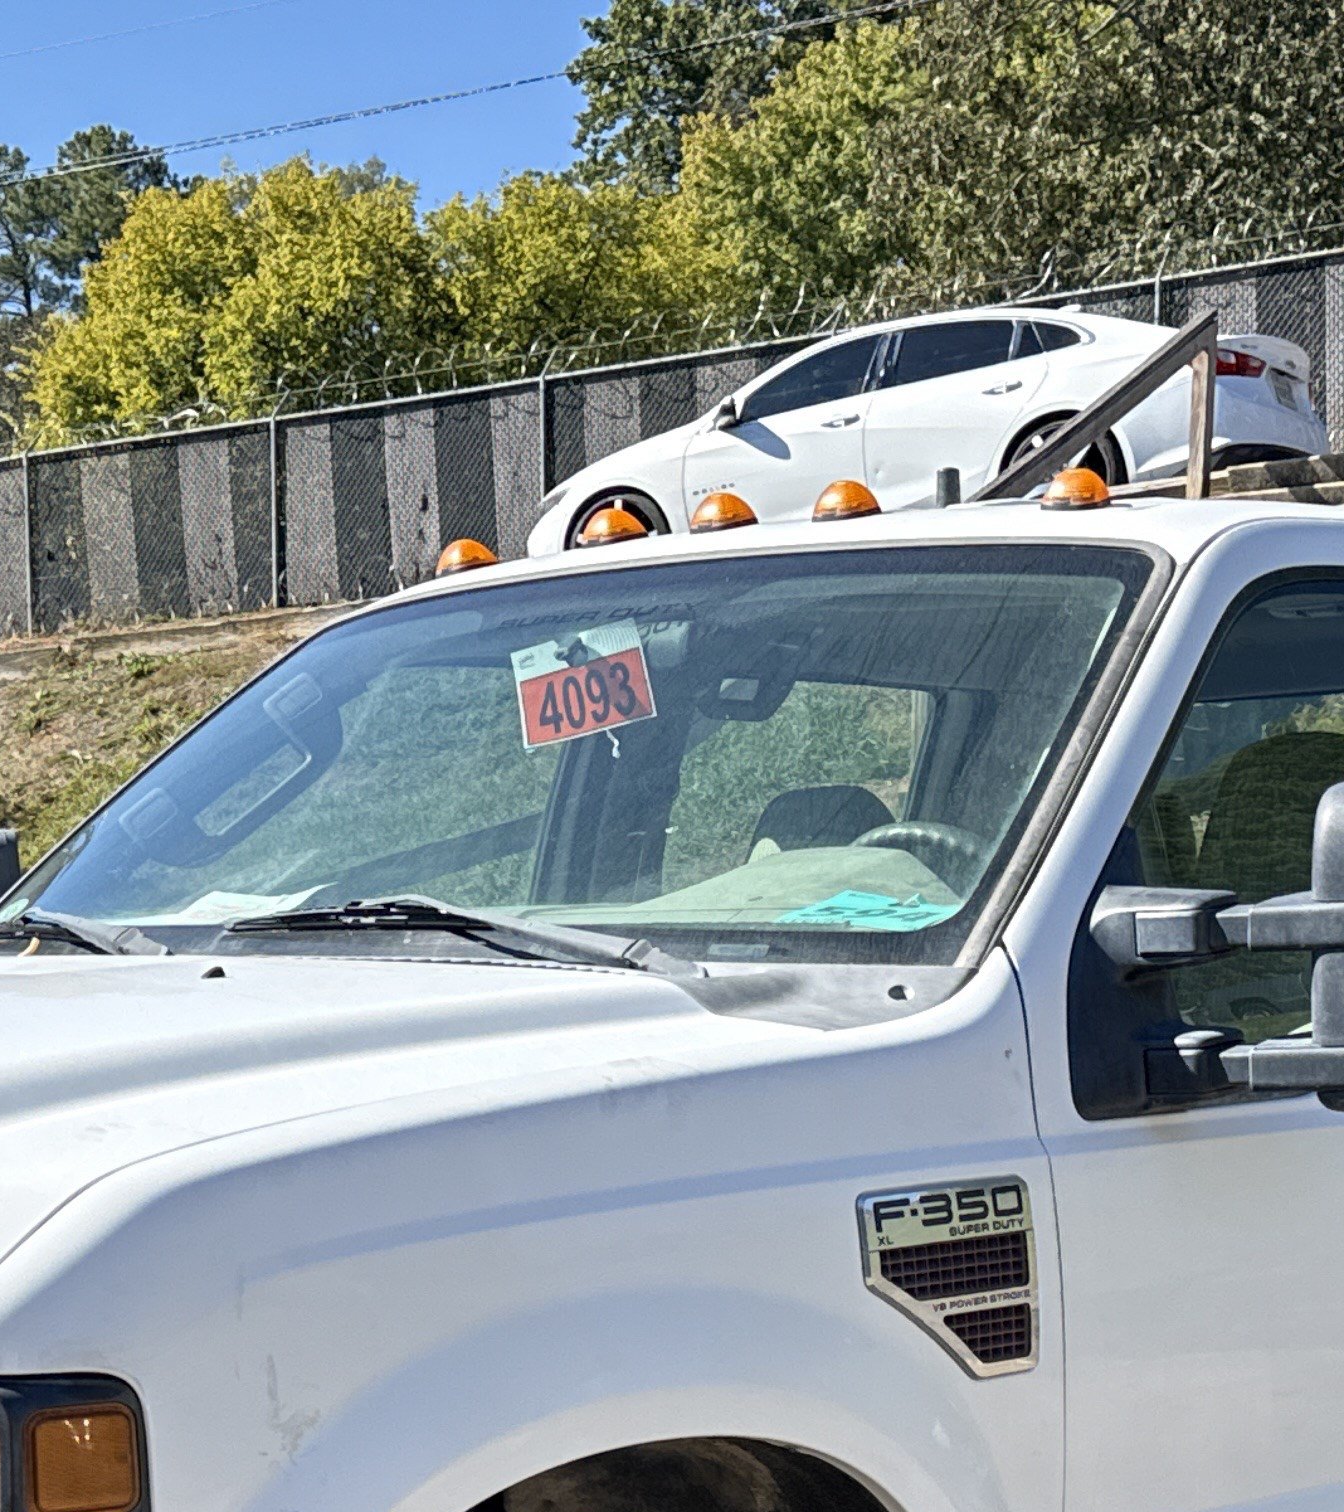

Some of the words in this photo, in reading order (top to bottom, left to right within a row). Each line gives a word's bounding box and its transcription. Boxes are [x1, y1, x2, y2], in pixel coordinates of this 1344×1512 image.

[539, 661, 636, 734] 4093
[948, 1223, 989, 1236] SUPER
[992, 1217, 1024, 1231] DUTY
[877, 1235, 894, 1246] XL
[932, 1302, 946, 1312] V8
[949, 1295, 988, 1309] POWER
[989, 1288, 1031, 1304] STROKE
